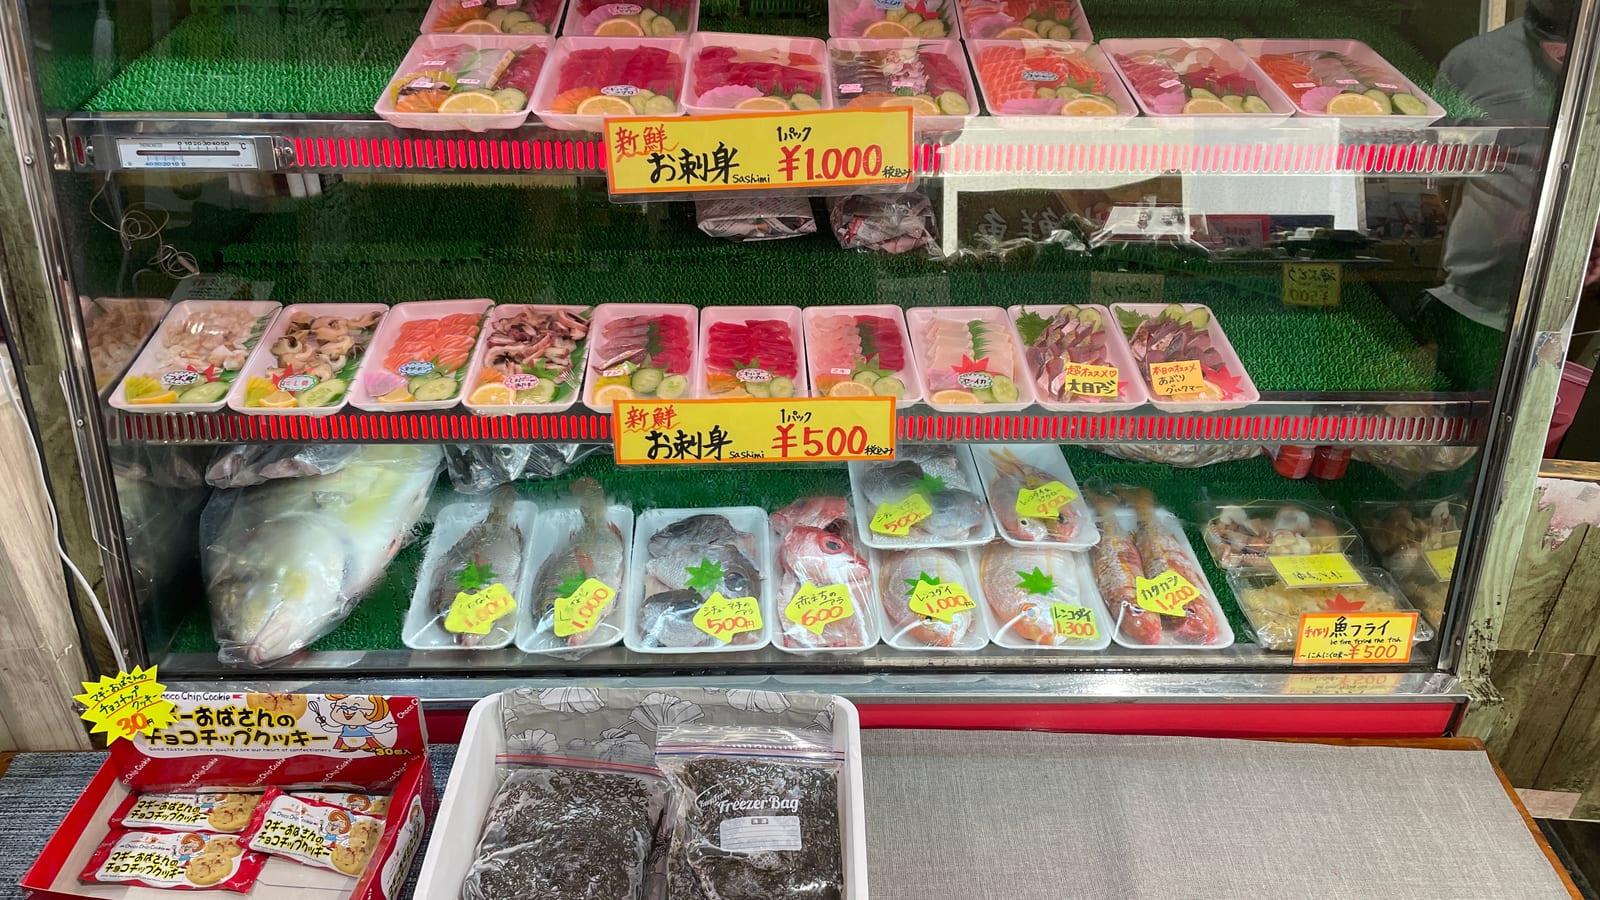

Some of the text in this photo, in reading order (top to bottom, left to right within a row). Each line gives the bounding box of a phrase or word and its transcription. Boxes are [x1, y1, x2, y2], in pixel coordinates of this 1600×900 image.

[615, 124, 668, 153] 新鮮
[647, 142, 739, 184] お刺身
[1067, 365, 1109, 378] 超オススメ
[1152, 363, 1197, 375] 本日のオススメ
[1158, 374, 1185, 386] あぶり
[624, 405, 677, 429] 新鮮
[780, 409, 812, 423] 1パック
[645, 425, 733, 461] お刺身
[772, 424, 867, 458] ¥500
[801, 606, 844, 627] 600
[1054, 607, 1092, 622] レンコダイ
[707, 617, 755, 634] 500円
[1329, 616, 1390, 638] 魚フライ
[1349, 643, 1398, 659] ¥500
[181, 692, 202, 702] Chip
[203, 692, 231, 701] Cookie
[116, 713, 154, 736] 30円
[145, 728, 329, 747] チョコチップクッキー
[720, 795, 799, 814] Freezer Bag
